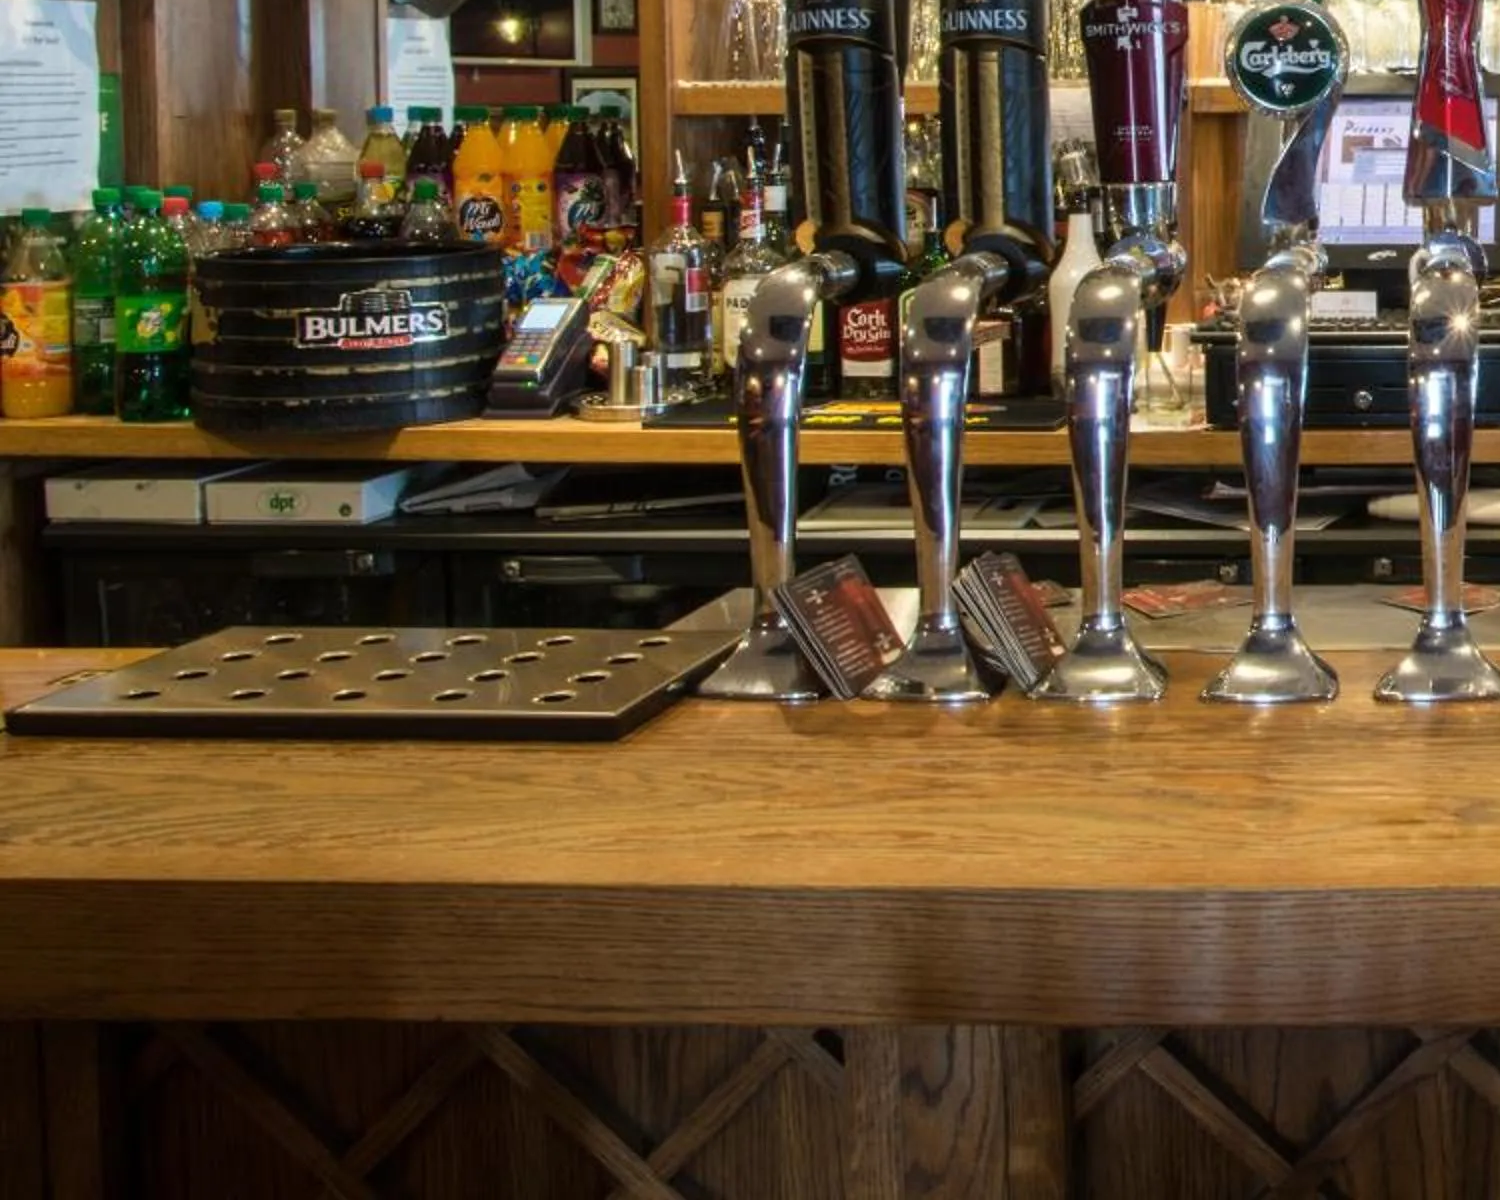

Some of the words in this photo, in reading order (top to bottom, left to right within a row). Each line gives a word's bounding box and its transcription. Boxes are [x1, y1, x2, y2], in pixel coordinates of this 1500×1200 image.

[1240, 40, 1333, 78] Carlsberg
[304, 309, 444, 341] BULMERS
[846, 307, 887, 328] Cork
[269, 492, 295, 512] dpt
